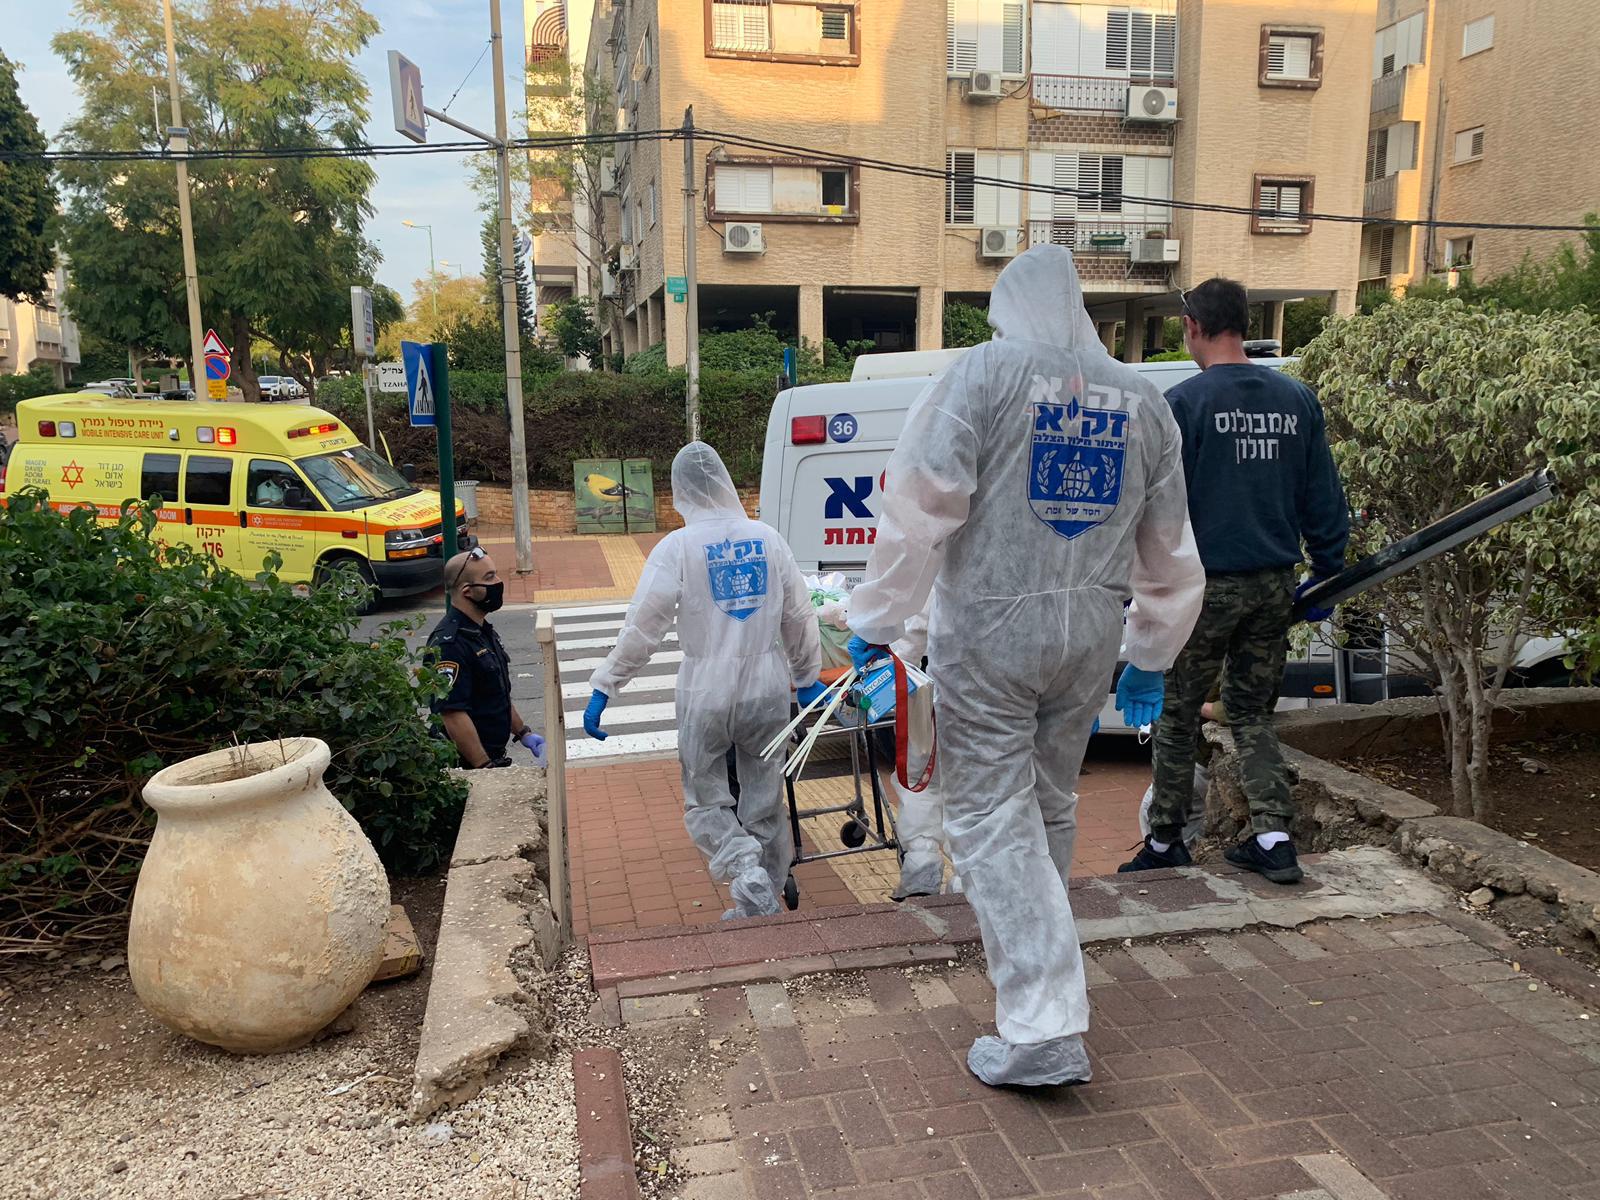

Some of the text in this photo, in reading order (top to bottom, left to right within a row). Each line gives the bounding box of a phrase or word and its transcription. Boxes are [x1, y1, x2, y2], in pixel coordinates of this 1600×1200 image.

[80, 416, 164, 428] ניידת טיפול נמרץ
[1214, 408, 1298, 435] אמבולנס
[81, 429, 164, 439] MOBILE INTENSIVE CARE UNIT
[833, 421, 854, 436] 36
[1033, 433, 1065, 443] הצלה
[1235, 436, 1280, 464] חולון
[97, 462, 124, 471] מגן דוד
[105, 471, 123, 479] אדום
[94, 478, 123, 488] בישראל
[159, 510, 177, 520] ADOM
[1065, 503, 1079, 515] של
[196, 527, 225, 539] ירקון
[202, 542, 224, 558] 176
[864, 671, 892, 694] HYCARE
